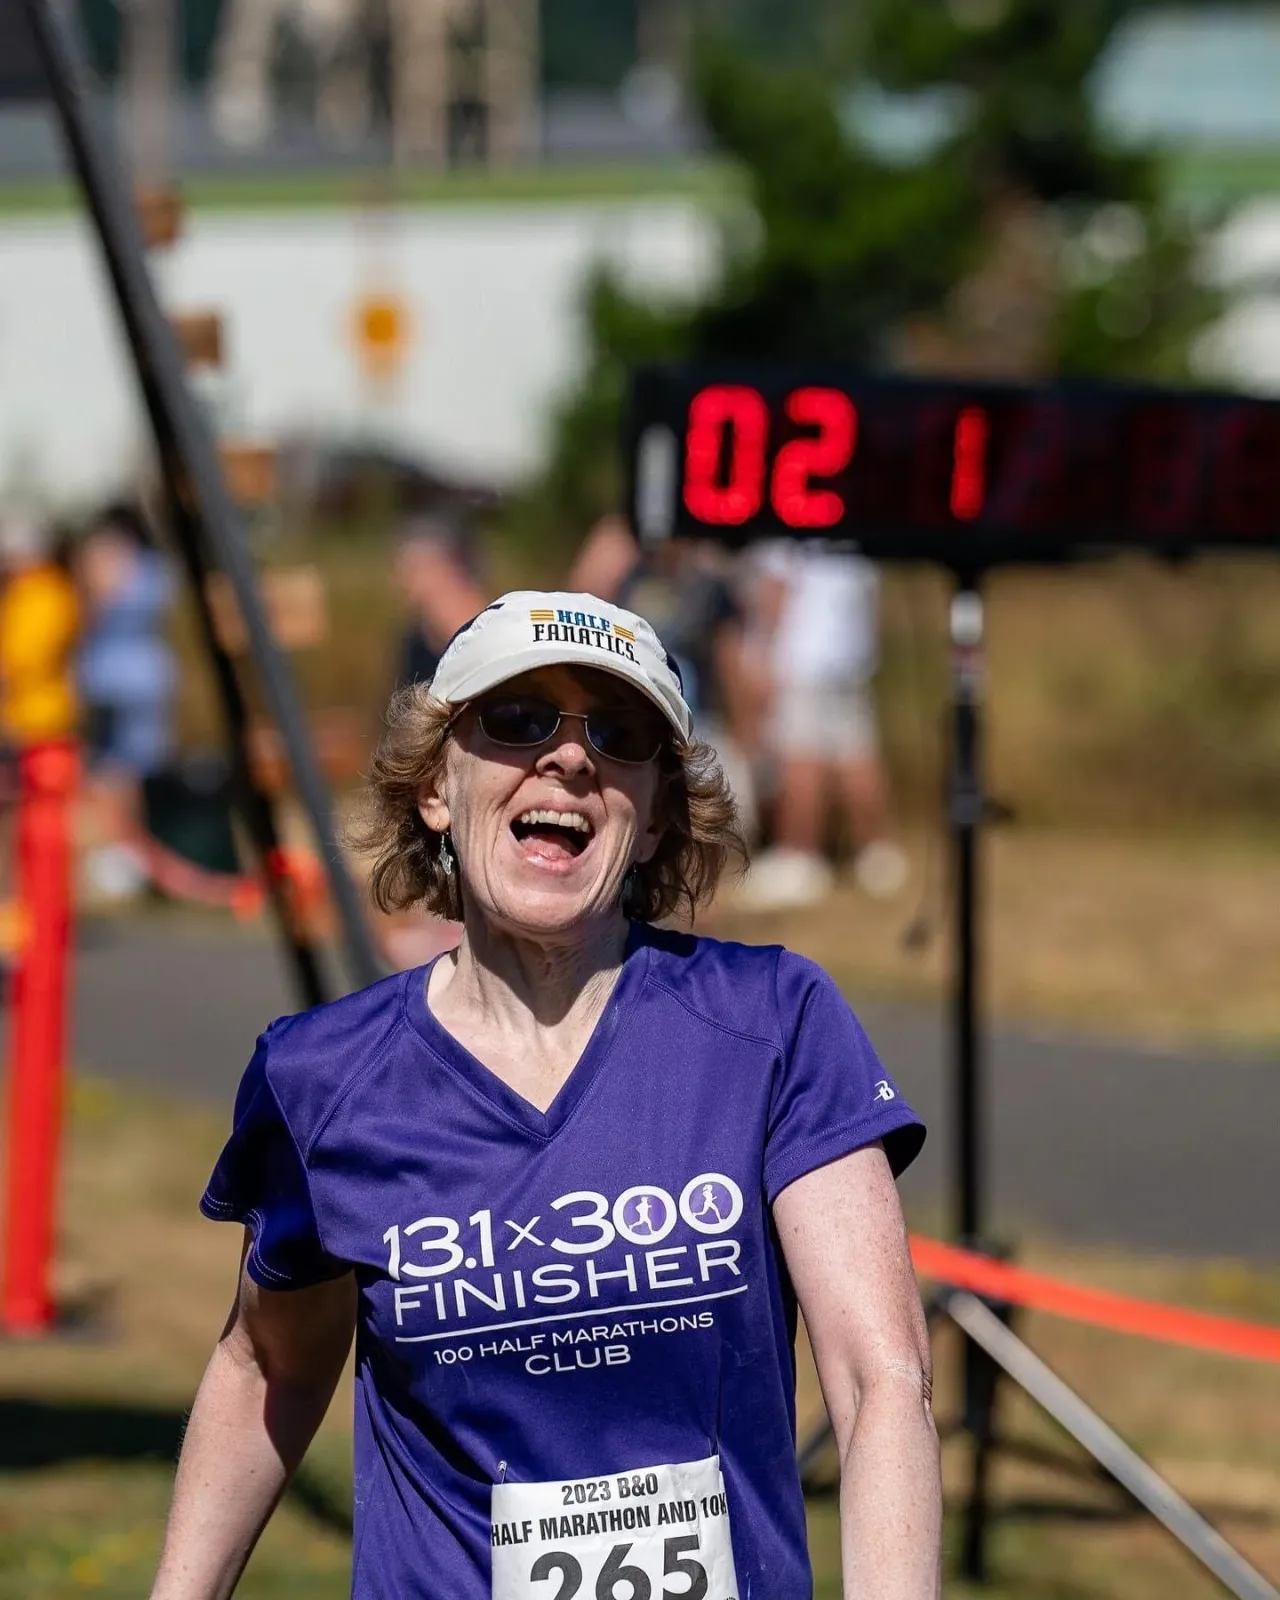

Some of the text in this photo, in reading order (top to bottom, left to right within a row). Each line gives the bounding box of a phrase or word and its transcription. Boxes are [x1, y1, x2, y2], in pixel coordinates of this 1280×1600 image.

[684, 384, 858, 528] 02
[532, 623, 637, 662] FANATICS
[556, 609, 611, 633] HALF
[383, 1209, 495, 1281] 13.1
[549, 1172, 744, 1255] 300
[394, 1239, 742, 1326] FINISHER
[433, 1312, 715, 1365] 100 HALF MARATHONS
[525, 1344, 632, 1376] CLUB
[561, 1472, 659, 1506] 2023 B&O
[491, 1520, 533, 1547] HALF
[539, 1505, 651, 1541] MARATHON
[657, 1499, 697, 1526] AND
[530, 1534, 709, 1600] 265
